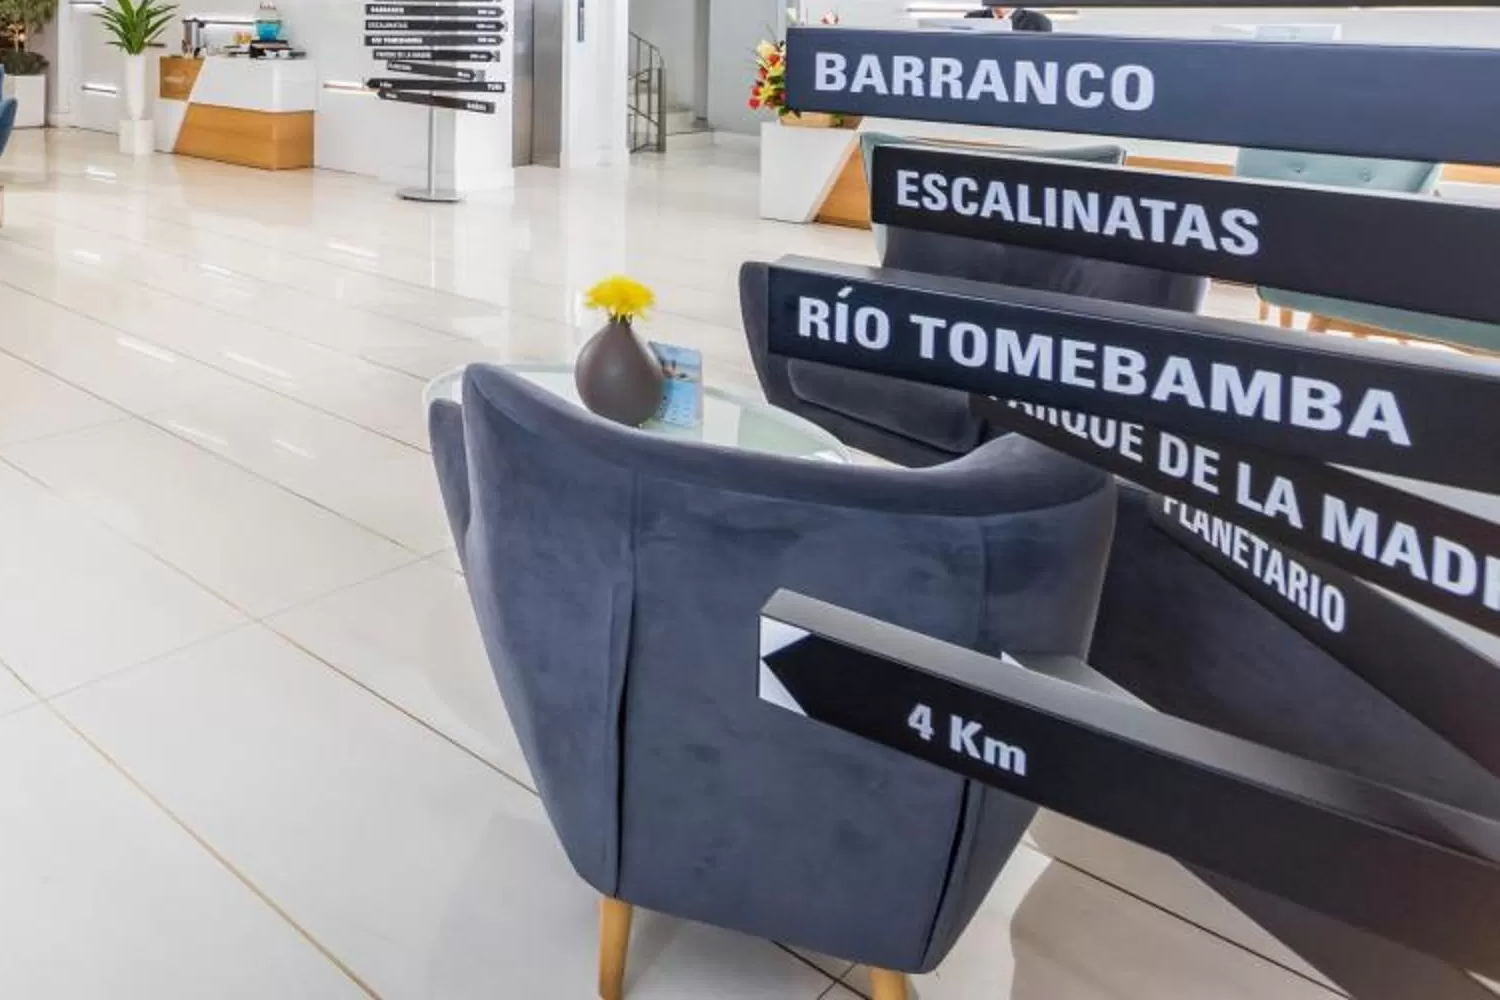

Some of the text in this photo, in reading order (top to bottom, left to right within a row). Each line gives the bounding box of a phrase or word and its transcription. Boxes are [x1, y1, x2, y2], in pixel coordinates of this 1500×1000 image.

[813, 51, 1156, 111] BARRANCO
[897, 169, 1259, 256] ESCALINATAS
[798, 286, 1412, 447] RÍO TOMEBAMBA
[1158, 431, 1220, 494] DE
[1236, 461, 1303, 530] LA
[907, 703, 1027, 777] 4 Km
